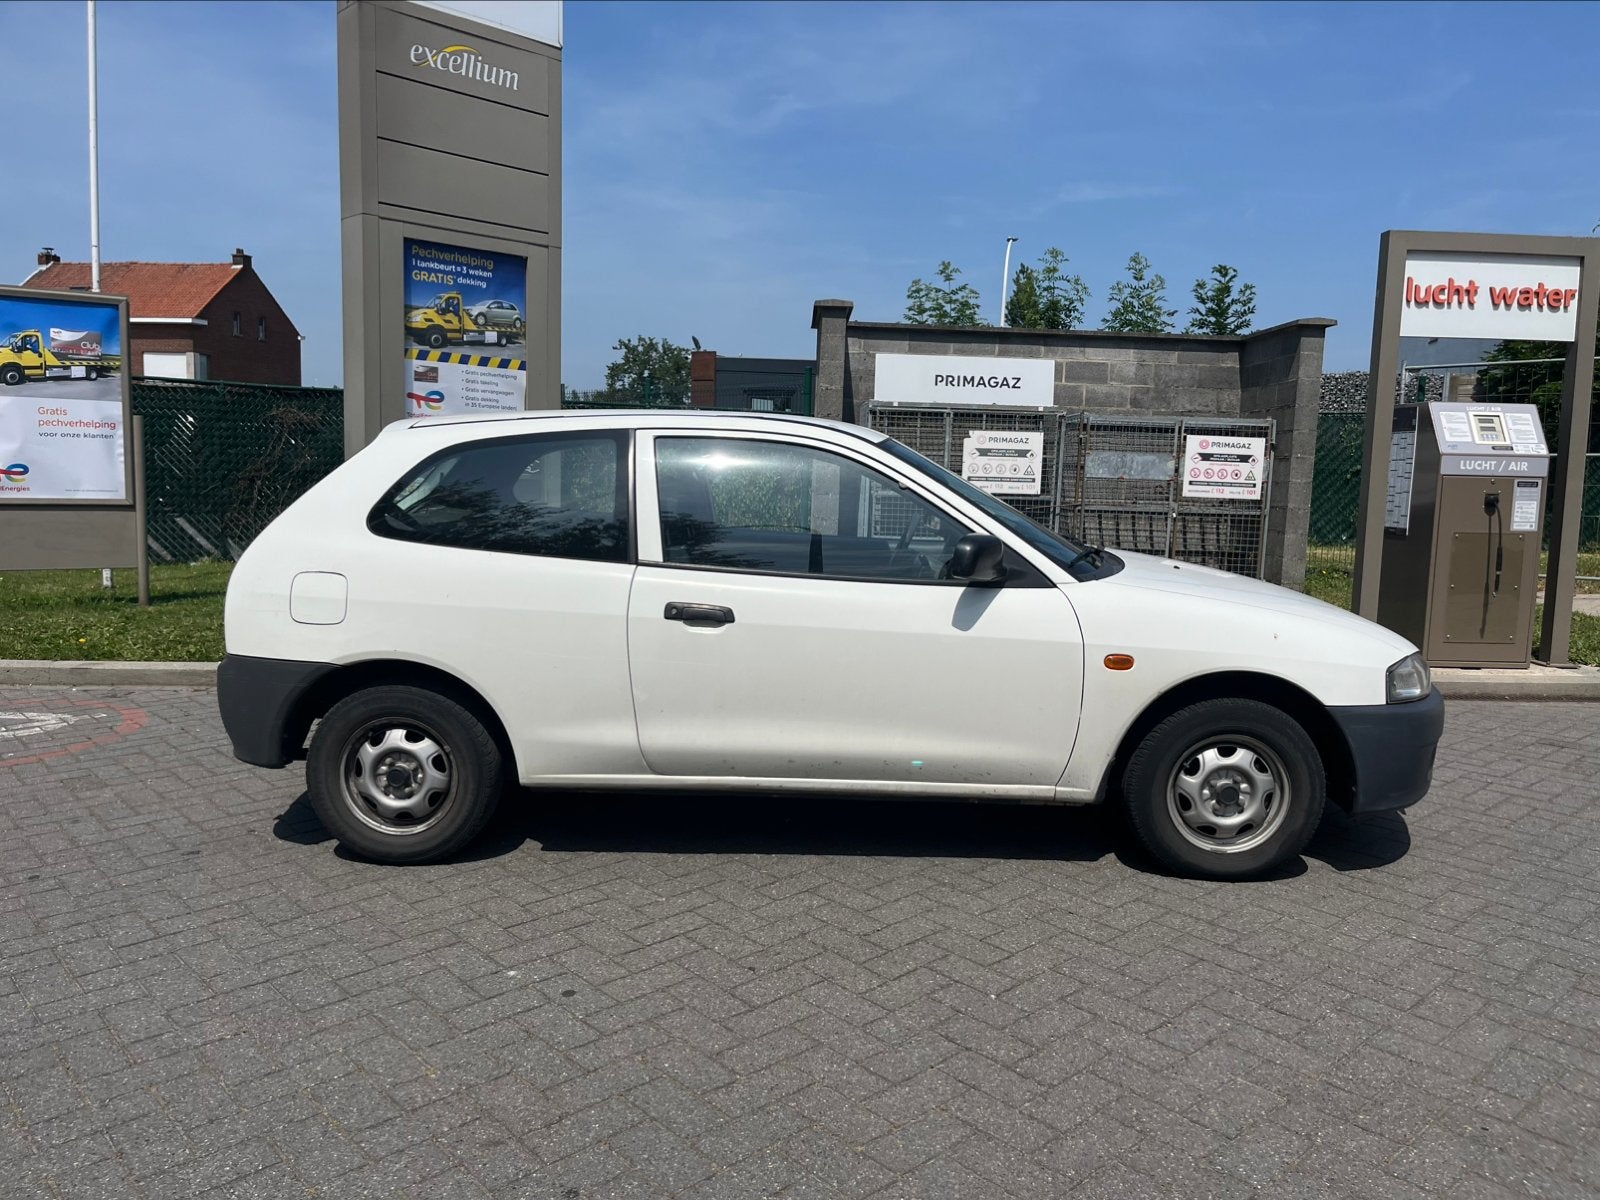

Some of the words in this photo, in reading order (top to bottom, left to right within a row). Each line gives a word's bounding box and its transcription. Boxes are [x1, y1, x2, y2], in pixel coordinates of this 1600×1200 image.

[410, 44, 519, 91] excellium
[412, 245, 494, 270] Pechverhelping
[417, 260, 456, 272] tankbeurt
[462, 266, 467, 274] 3
[468, 268, 493, 278] weken
[457, 276, 487, 289] dekking
[1406, 276, 1480, 307] lucht
[1489, 282, 1577, 309] water
[934, 374, 1021, 389] PRIMAGAZ
[37, 406, 68, 416] Gratis
[38, 418, 117, 430] pechverhelping
[988, 436, 1030, 444] PRIMAGAZ
[1211, 441, 1252, 449] PRIMAGAZ
[1459, 460, 1497, 470] LUCHT
[1508, 461, 1529, 472] AIR
